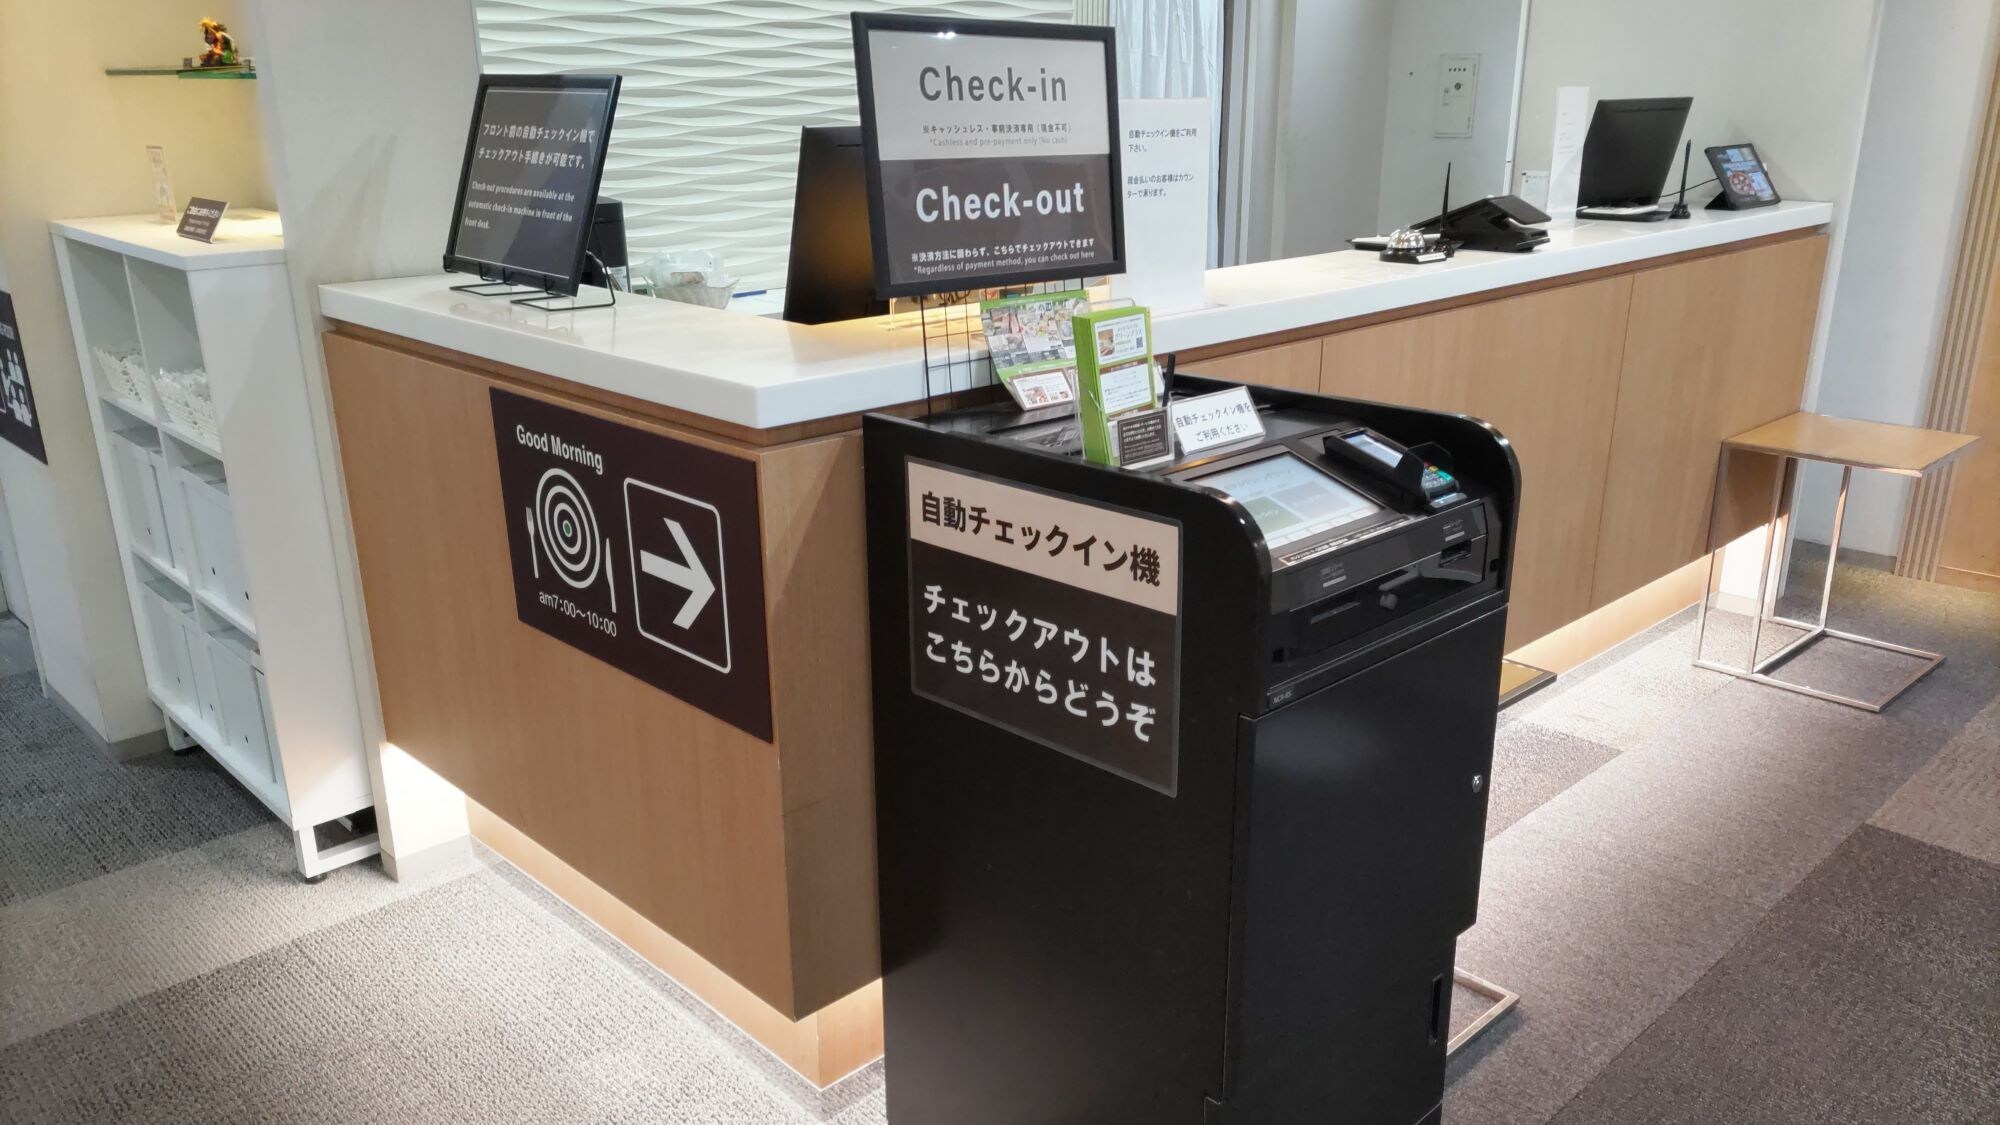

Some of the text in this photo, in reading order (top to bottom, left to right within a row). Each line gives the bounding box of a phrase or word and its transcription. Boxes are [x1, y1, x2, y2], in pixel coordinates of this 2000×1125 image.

[918, 65, 1067, 102] Check-in
[483, 124, 596, 143] フロント前の自動チェックイン機で
[964, 138, 978, 146] and
[979, 137, 1022, 147] pre-payment
[1023, 136, 1038, 145] only
[1128, 128, 1197, 139] 自動チェックイン機をご利用
[478, 147, 585, 168] チェックアウト手続きが可能です。
[1128, 144, 1147, 152] 下さい。
[1127, 174, 1194, 185] 現金払いのお客様はカウン
[495, 185, 523, 195] procedures
[523, 189, 533, 197] are
[533, 189, 557, 199] available
[565, 192, 575, 202] the
[916, 182, 1084, 223] Check-out
[468, 200, 573, 222] automatic check-in machine in front of the
[464, 217, 478, 228] front
[956, 260, 964, 270] of
[965, 259, 995, 271] payment
[1024, 256, 1037, 266] you
[1037, 255, 1049, 263] can
[1050, 252, 1068, 262] check
[1069, 252, 1080, 260] out
[1081, 250, 1095, 259] here
[1175, 402, 1252, 428] 自動チェックイン機を
[1196, 423, 1249, 442] ご利用ください
[516, 424, 604, 475] Good Morning
[921, 490, 1161, 588] 自動チェックイン機
[923, 584, 1156, 687] チェックアウトは
[926, 631, 1156, 743] こちらからどうぞ
